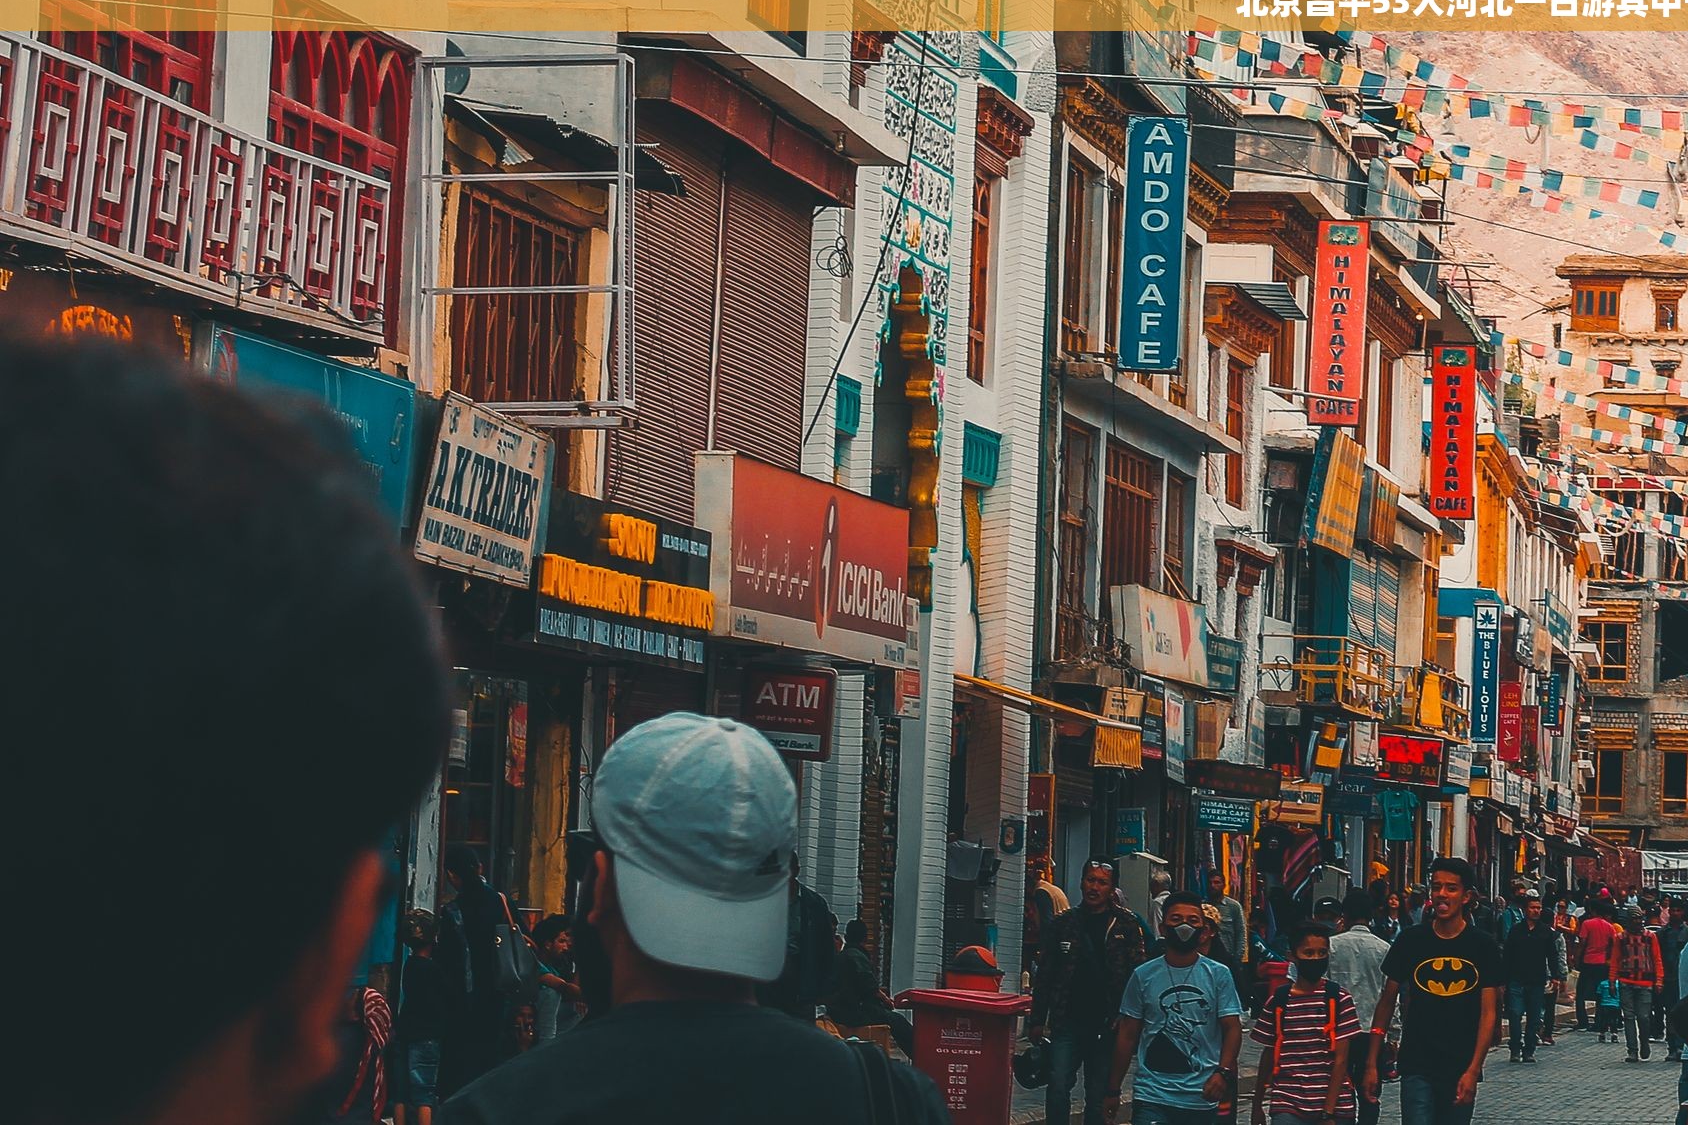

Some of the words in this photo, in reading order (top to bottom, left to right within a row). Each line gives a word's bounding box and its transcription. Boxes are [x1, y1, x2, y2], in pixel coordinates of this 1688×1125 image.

[1140, 123, 1174, 232] AMDO
[1137, 254, 1166, 364] CAFE
[1327, 255, 1351, 393] HIMALAYAN
[1315, 398, 1355, 415] CAFE
[1443, 375, 1462, 492] HIMALAYAN
[465, 452, 540, 541] TRADERS
[1435, 497, 1467, 511] CAFE
[837, 561, 872, 618] ICICI
[872, 570, 905, 627] Bank
[1478, 631, 1495, 639] THE
[1482, 641, 1491, 679] BLUE
[755, 682, 820, 710] ATM
[1480, 686, 1490, 732] LOTUS
[790, 738, 814, 751] Bank
[1398, 764, 1413, 775] ISD
[1420, 766, 1437, 777] FAX
[1200, 801, 1251, 810] HIMALAYAN
